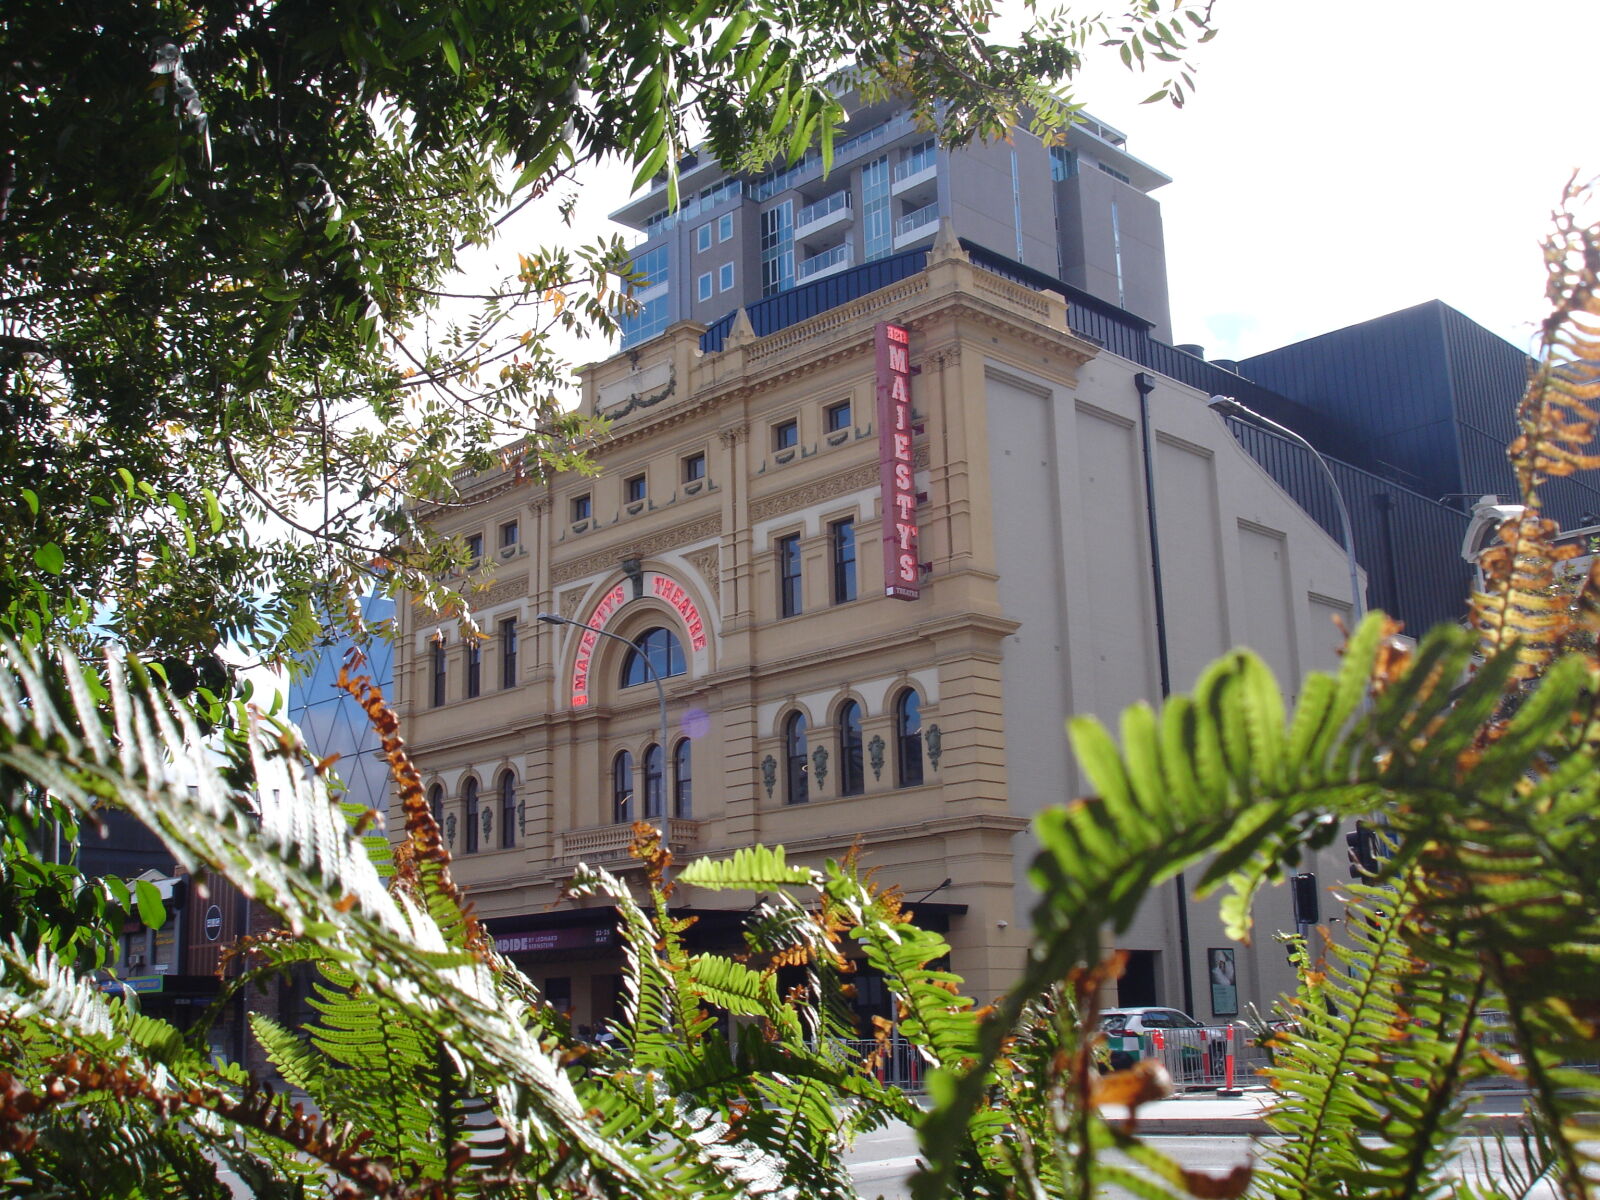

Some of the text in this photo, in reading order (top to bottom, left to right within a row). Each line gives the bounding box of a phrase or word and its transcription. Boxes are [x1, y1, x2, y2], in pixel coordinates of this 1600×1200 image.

[889, 345, 918, 582] MAJESTY'S
[652, 576, 707, 652] THEATRE
[495, 937, 528, 951] NDIDE
